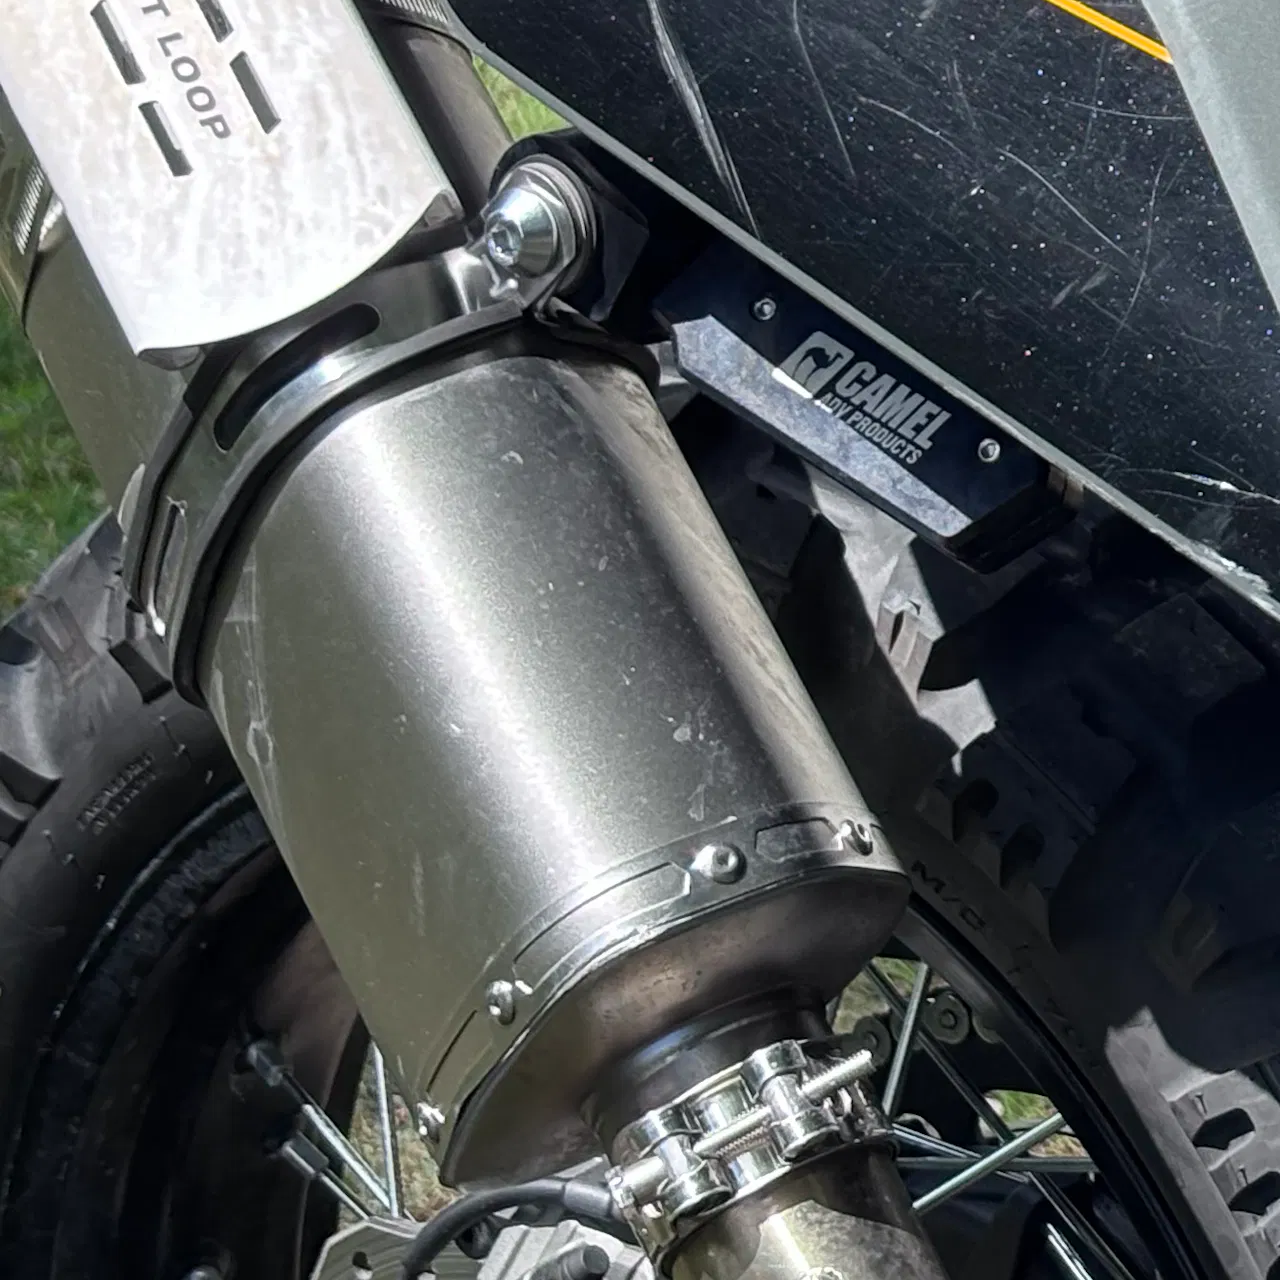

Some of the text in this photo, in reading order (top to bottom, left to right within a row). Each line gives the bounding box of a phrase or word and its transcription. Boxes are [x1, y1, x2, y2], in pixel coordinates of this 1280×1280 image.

[156, 31, 232, 139] LOOP
[834, 360, 953, 451] CAMEL
[845, 410, 923, 465] PRODUCTS
